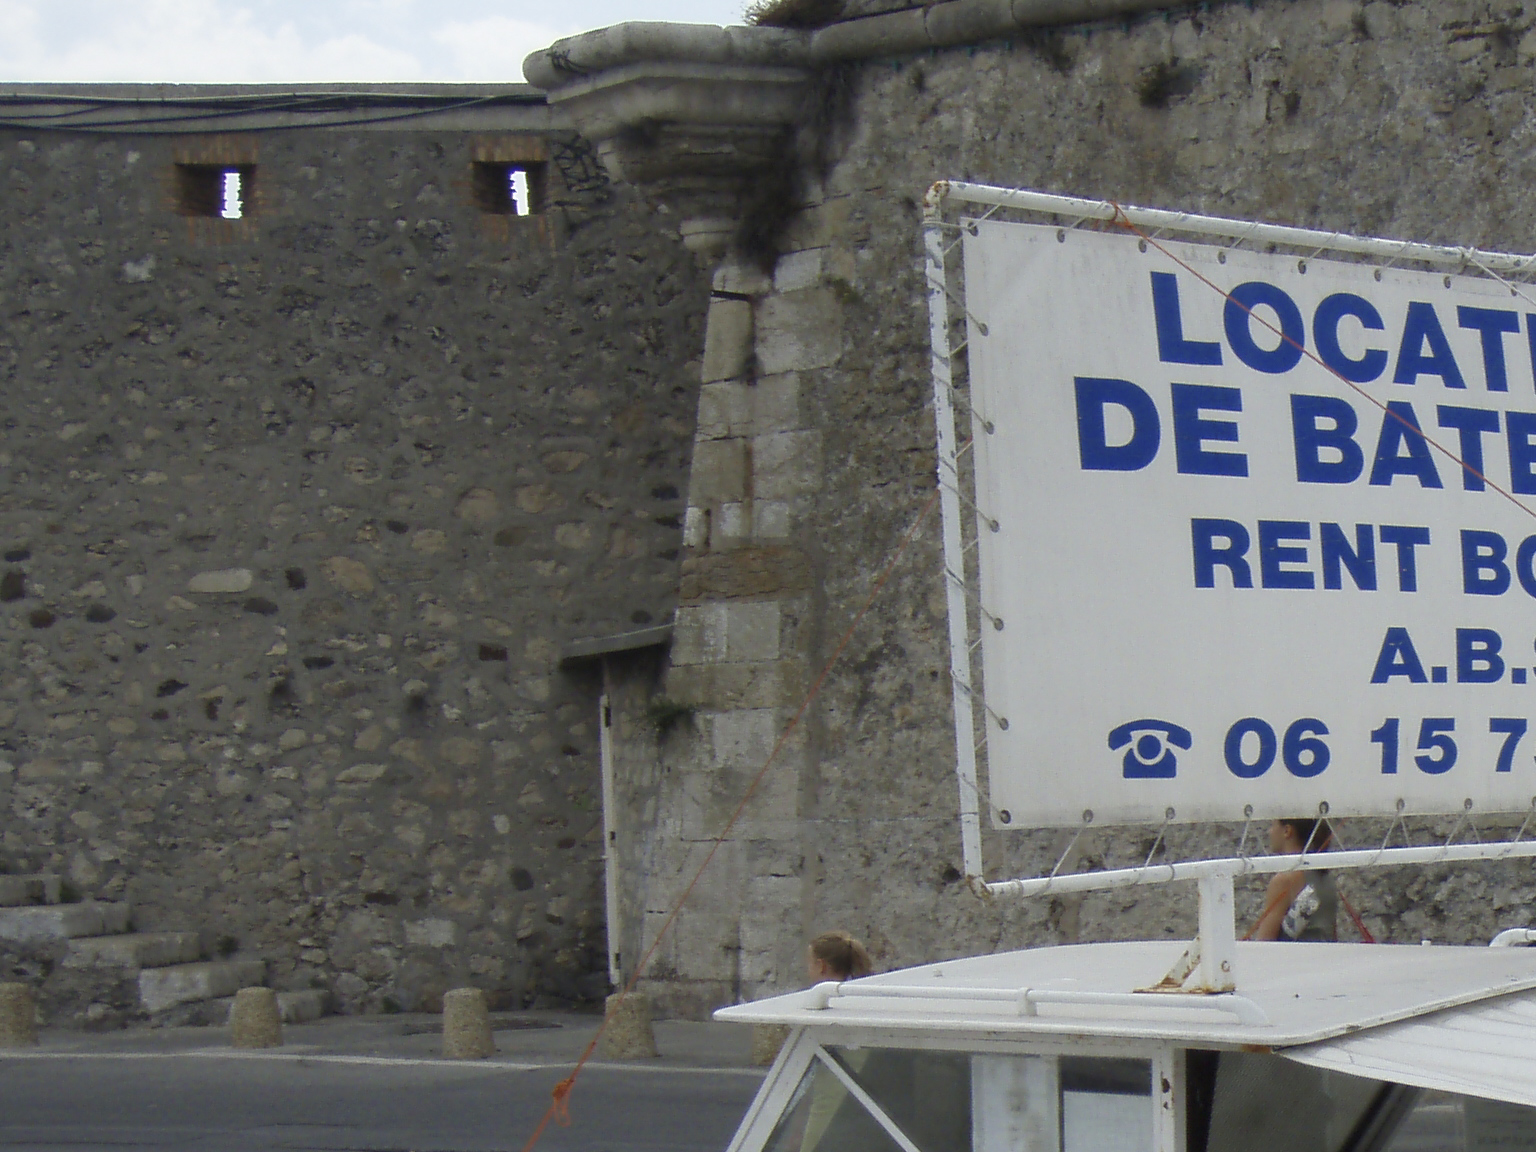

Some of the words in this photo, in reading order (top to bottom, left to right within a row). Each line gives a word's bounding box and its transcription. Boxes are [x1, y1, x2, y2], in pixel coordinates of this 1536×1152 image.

[1074, 377, 1249, 478] DE
[1191, 518, 1431, 593] RENT
[1224, 717, 1332, 779] 06
[1370, 718, 1459, 776] 15
